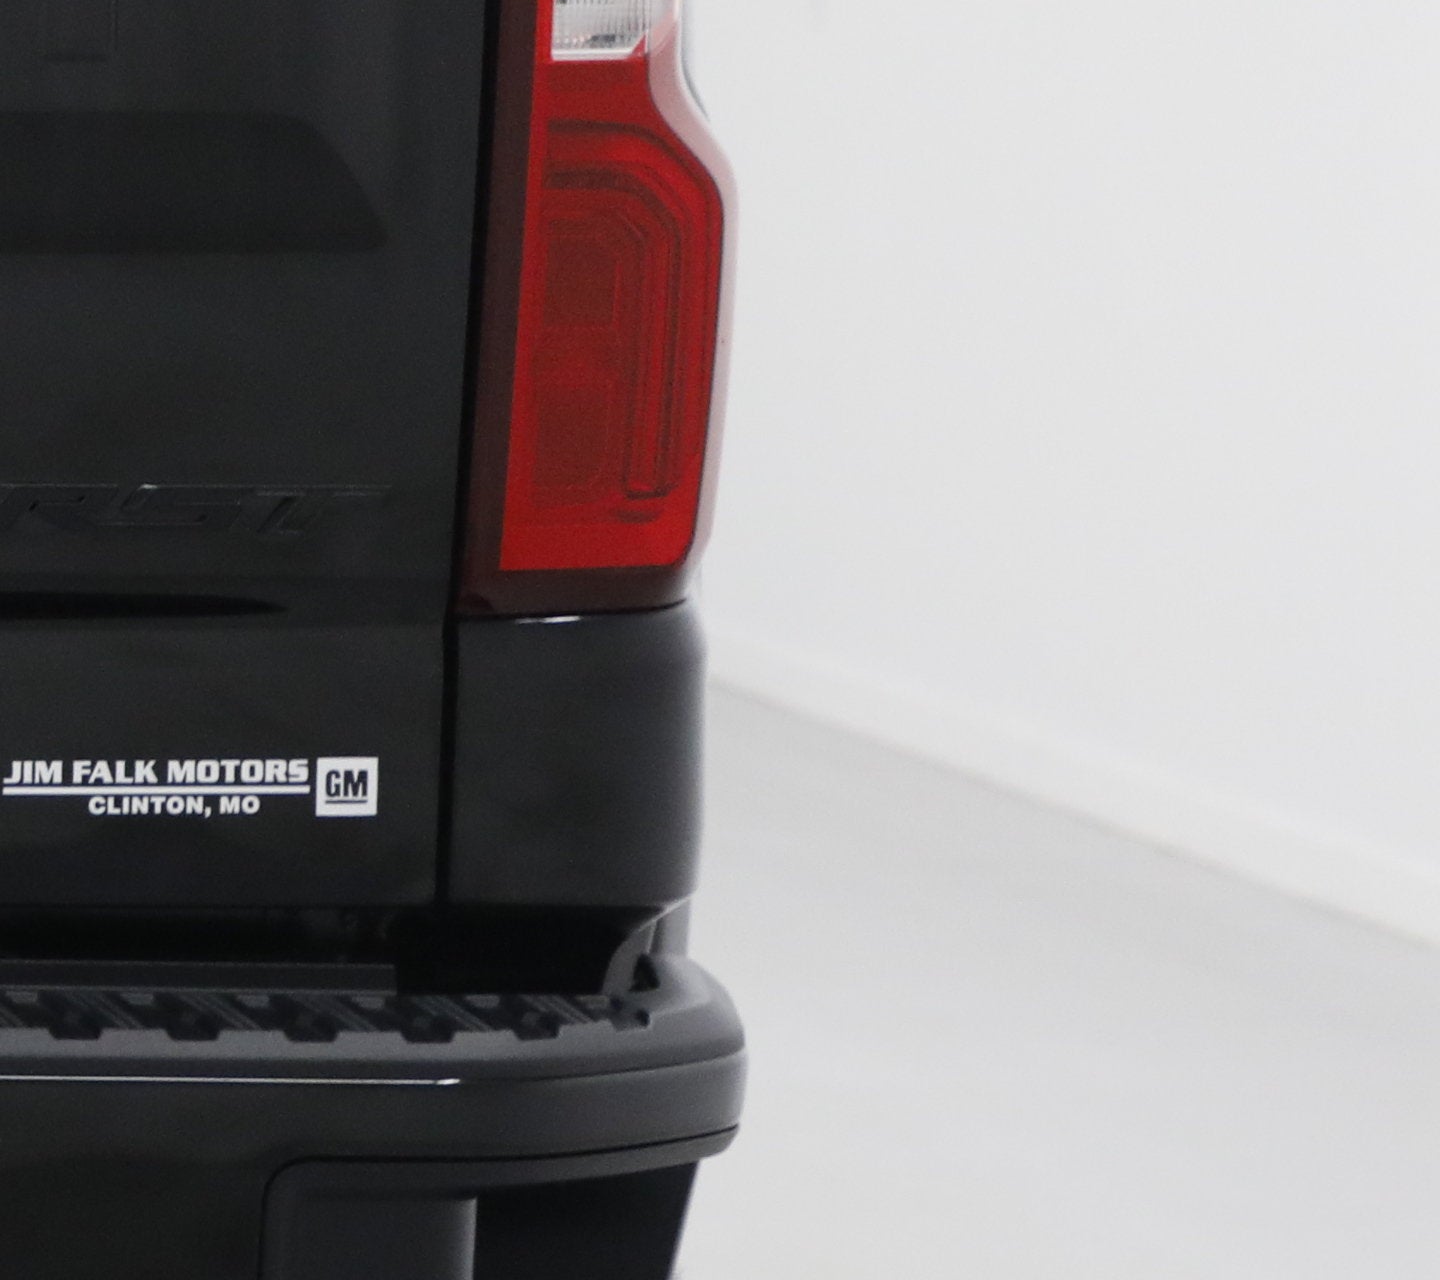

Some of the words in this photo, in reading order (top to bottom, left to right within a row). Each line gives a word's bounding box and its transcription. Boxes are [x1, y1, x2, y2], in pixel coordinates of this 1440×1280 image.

[3, 760, 63, 785] JIM
[72, 760, 159, 784] FALK
[167, 759, 310, 784] MOTORS
[325, 769, 369, 798] GM
[88, 795, 212, 818] CLINTON,
[219, 795, 261, 815] MO
